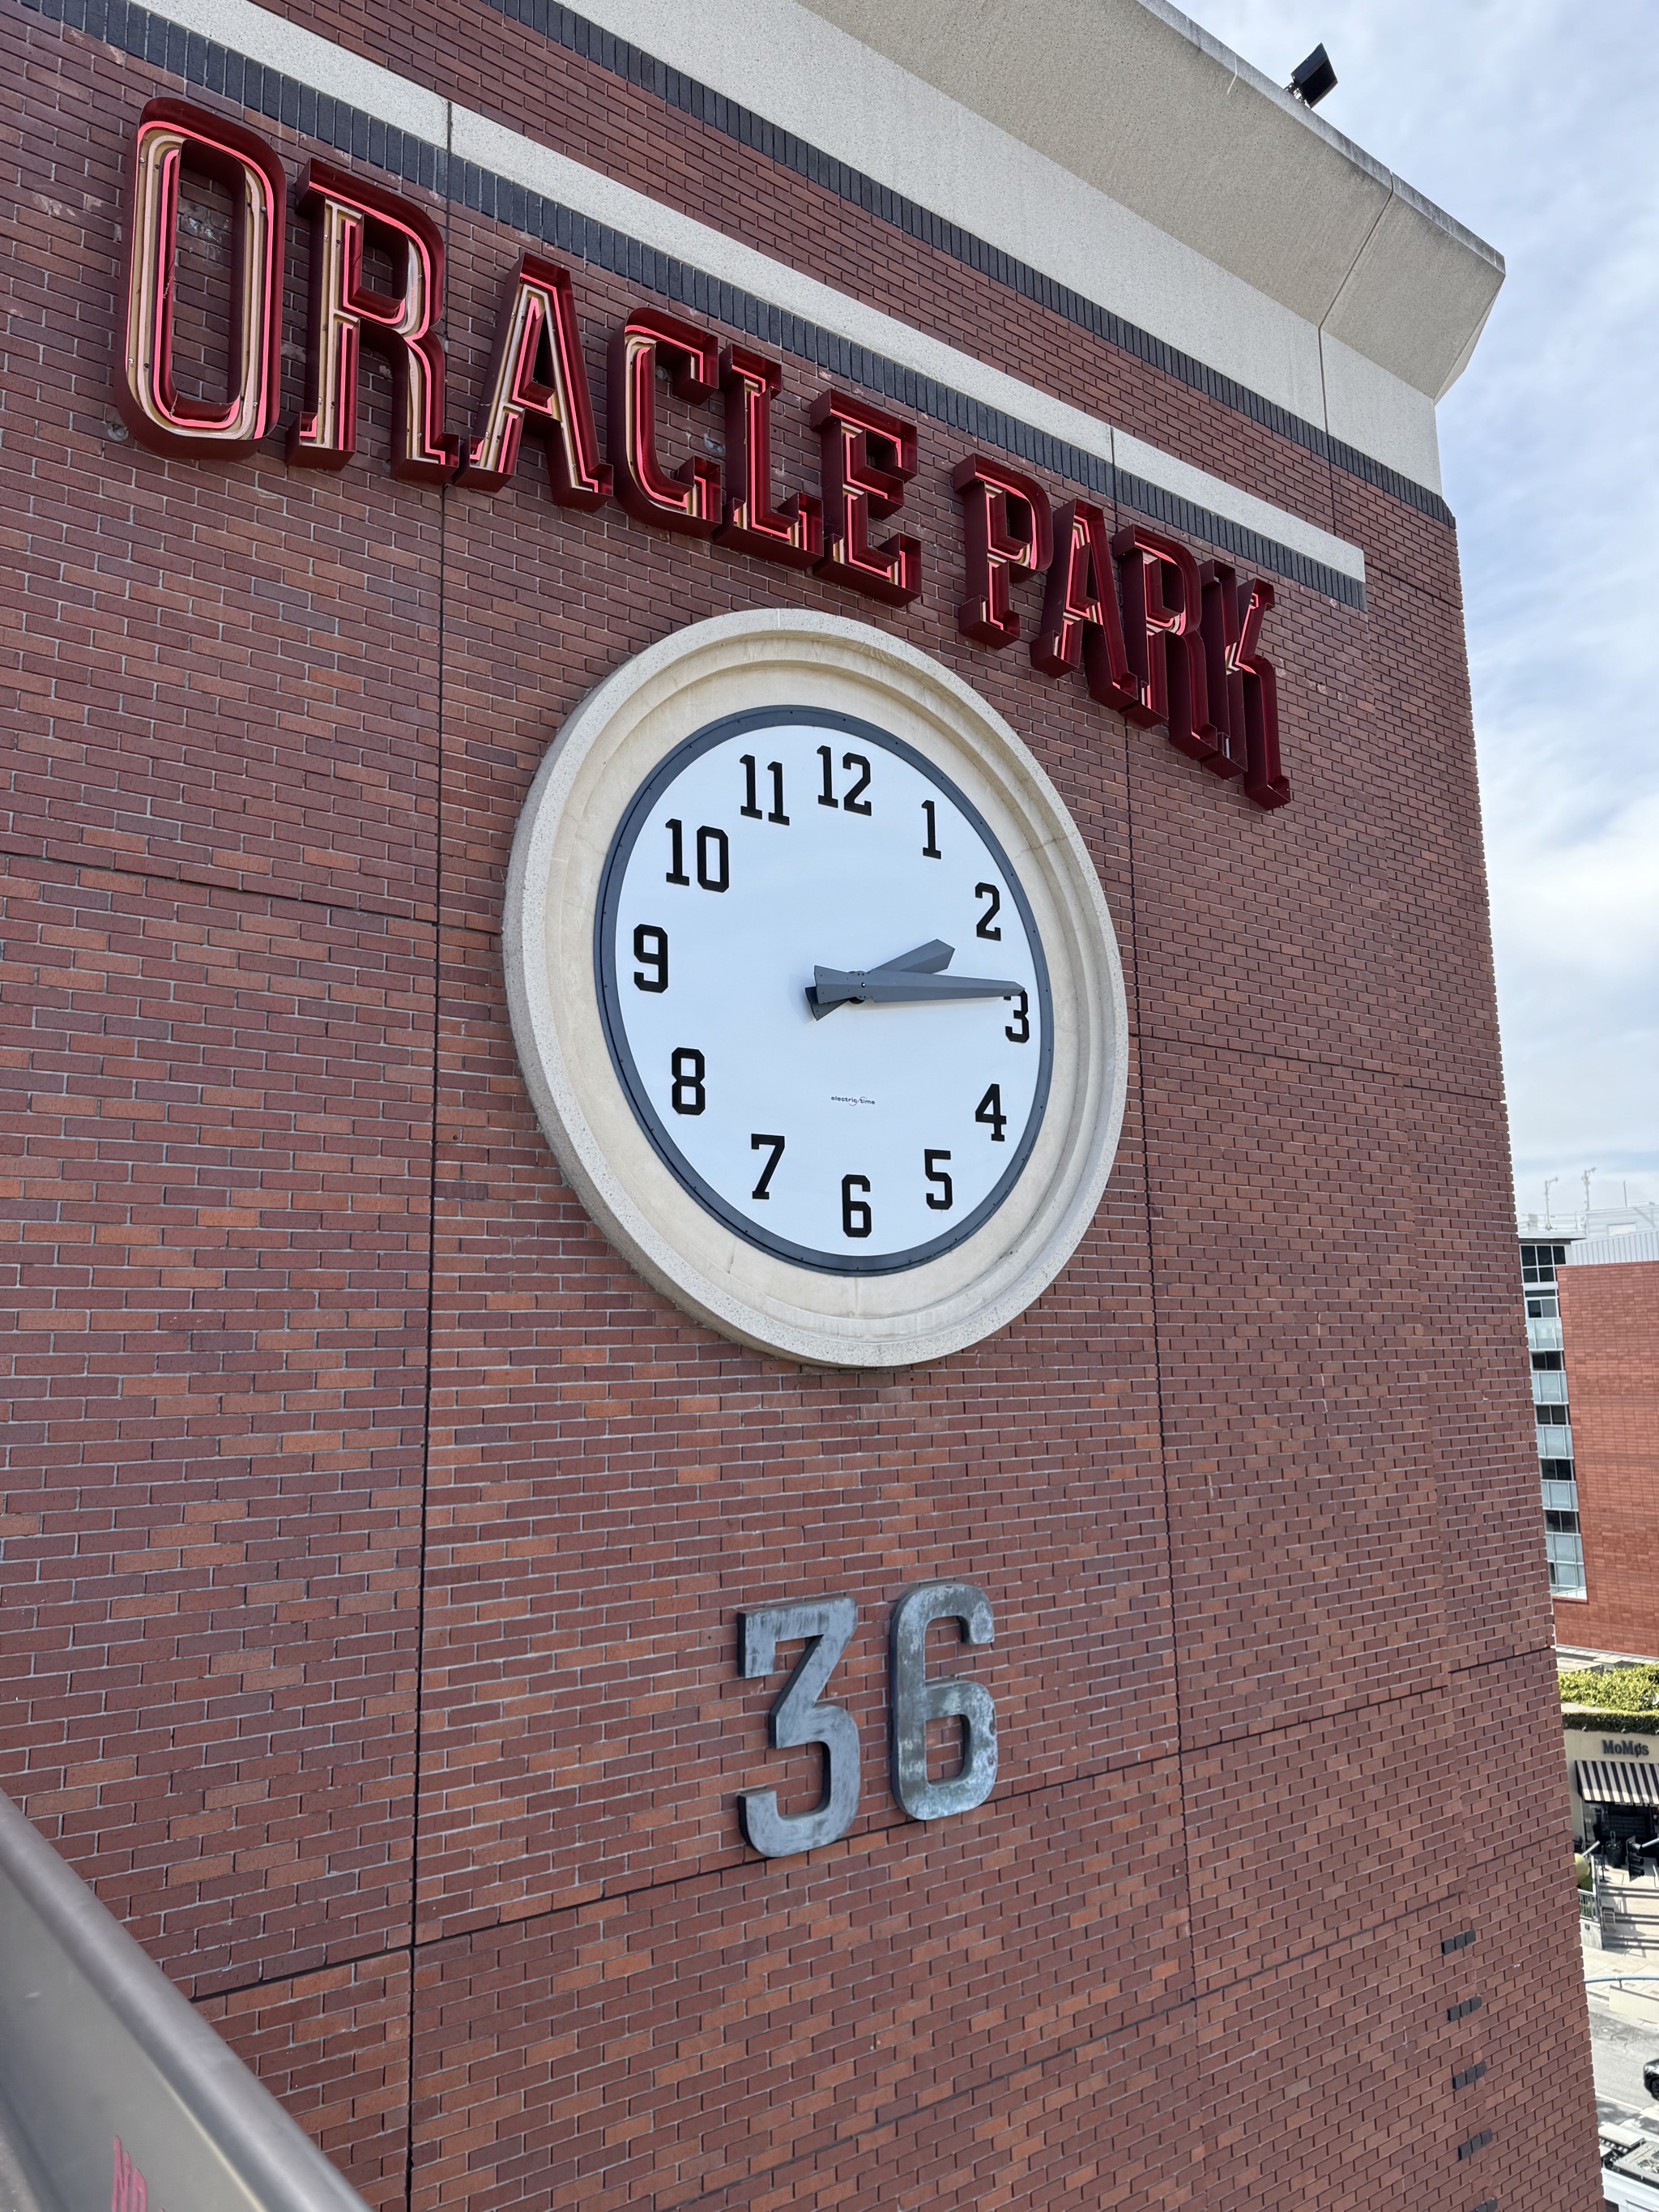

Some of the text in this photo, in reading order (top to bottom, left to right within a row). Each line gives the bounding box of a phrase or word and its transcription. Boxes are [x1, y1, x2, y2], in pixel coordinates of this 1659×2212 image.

[114, 96, 1291, 810] ORACLE PARK
[739, 754, 790, 826] 11
[817, 745, 872, 817] 12
[664, 818, 730, 893] 10
[921, 800, 942, 860] 1
[975, 882, 1001, 942] 2
[633, 924, 668, 993] 9
[1004, 989, 1030, 1044] 3
[671, 1047, 706, 1116] 8
[830, 1095, 859, 1104] electric
[975, 1083, 1007, 1142] 4
[751, 1133, 786, 1200] 7
[923, 1148, 953, 1211] 5
[841, 1174, 872, 1238] 6
[737, 1582, 999, 1858] 36
